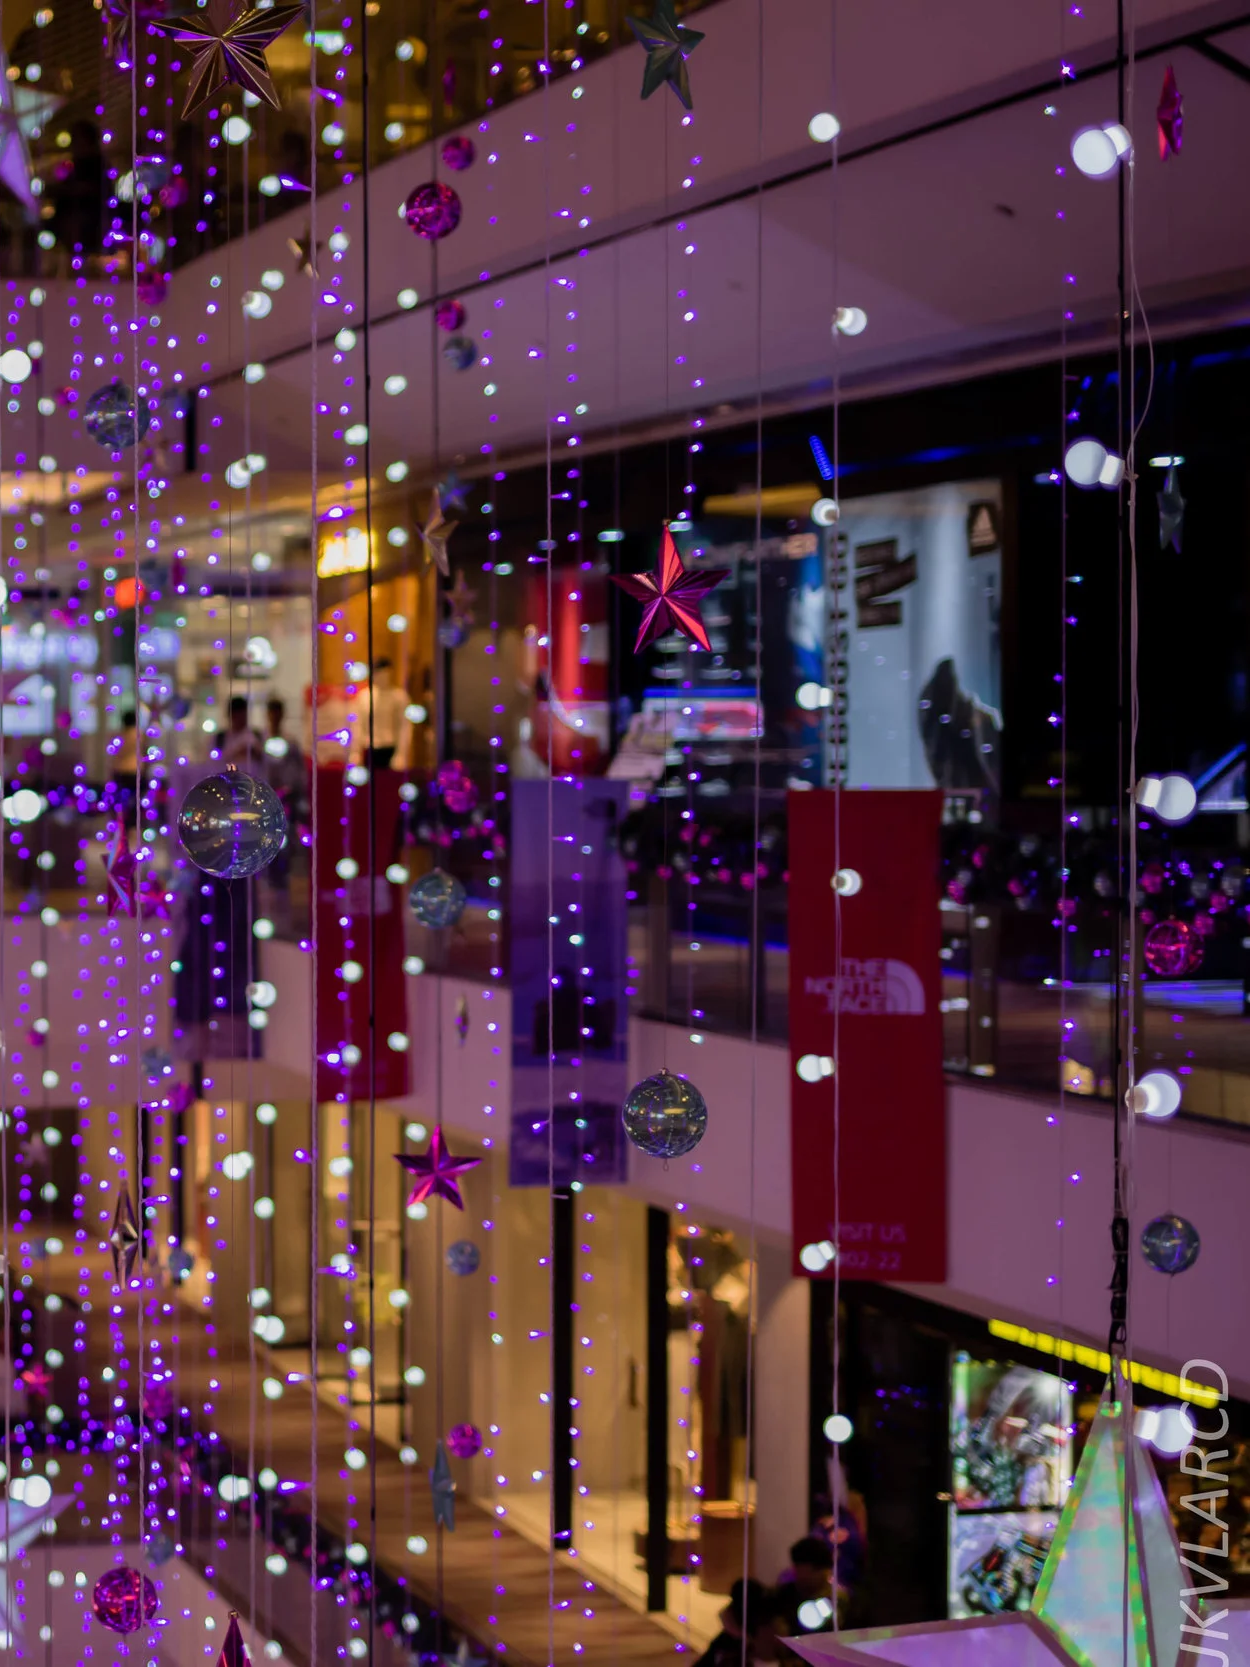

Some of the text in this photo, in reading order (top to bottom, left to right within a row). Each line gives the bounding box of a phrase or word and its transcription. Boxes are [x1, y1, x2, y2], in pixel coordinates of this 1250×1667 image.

[838, 957, 885, 976] THE
[804, 976, 885, 996] NORTH
[827, 995, 885, 1014] FACE
[879, 1222, 907, 1244] US
